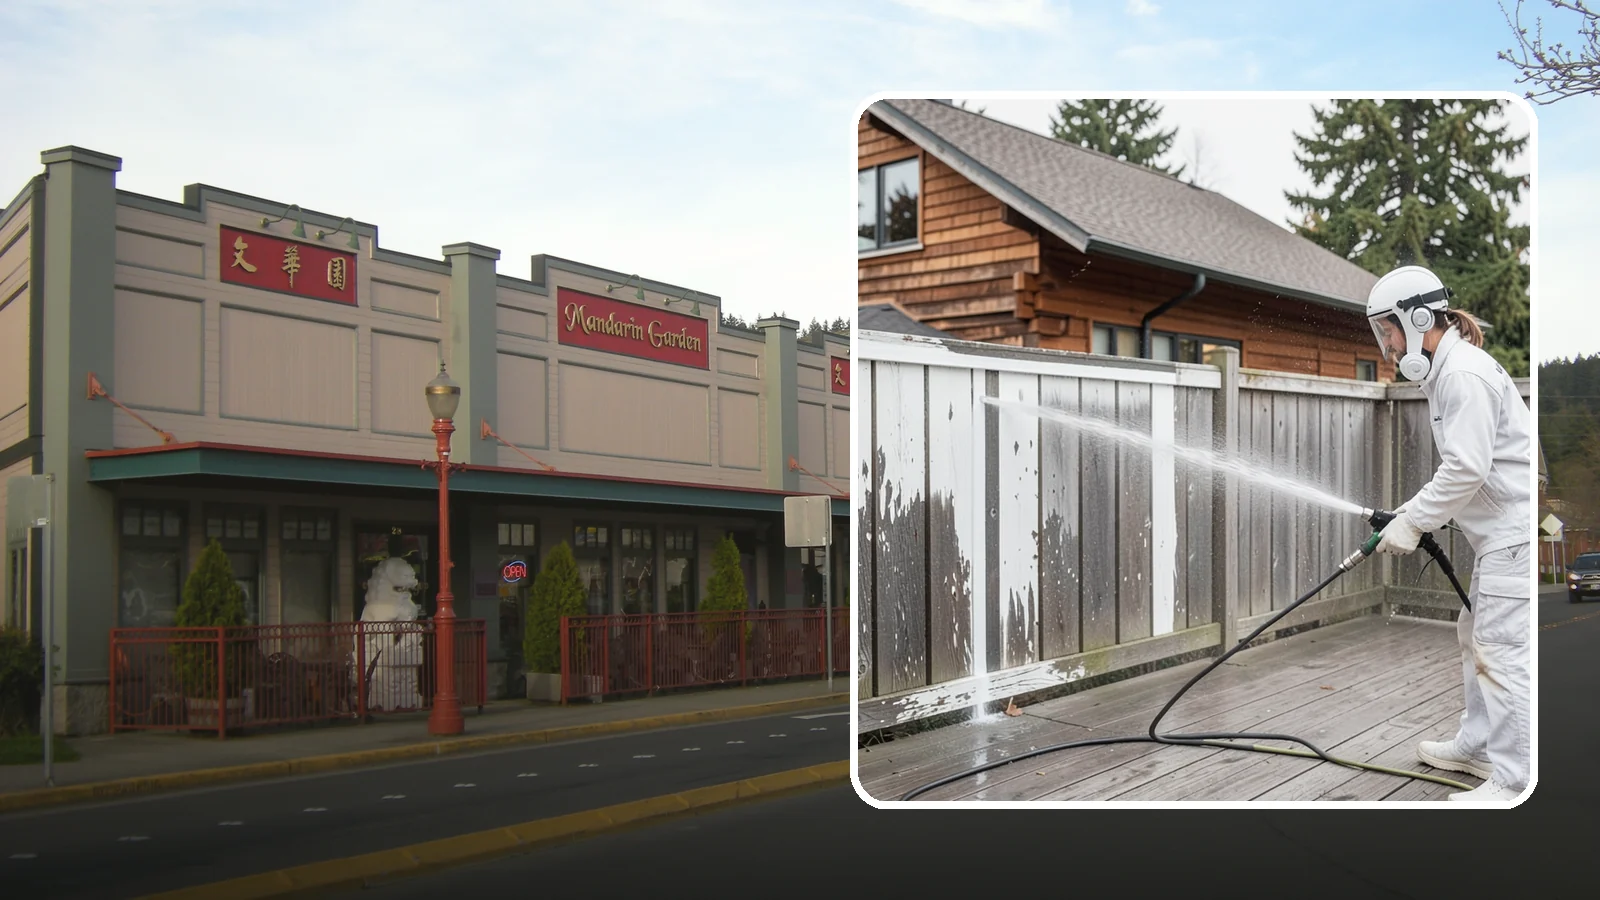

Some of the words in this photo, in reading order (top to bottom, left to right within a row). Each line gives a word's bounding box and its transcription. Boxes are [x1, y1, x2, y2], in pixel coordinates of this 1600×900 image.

[231, 236, 346, 290] 文華園
[565, 303, 644, 340] Mandarin
[648, 320, 701, 351] Garden
[503, 565, 527, 578] OPEN
